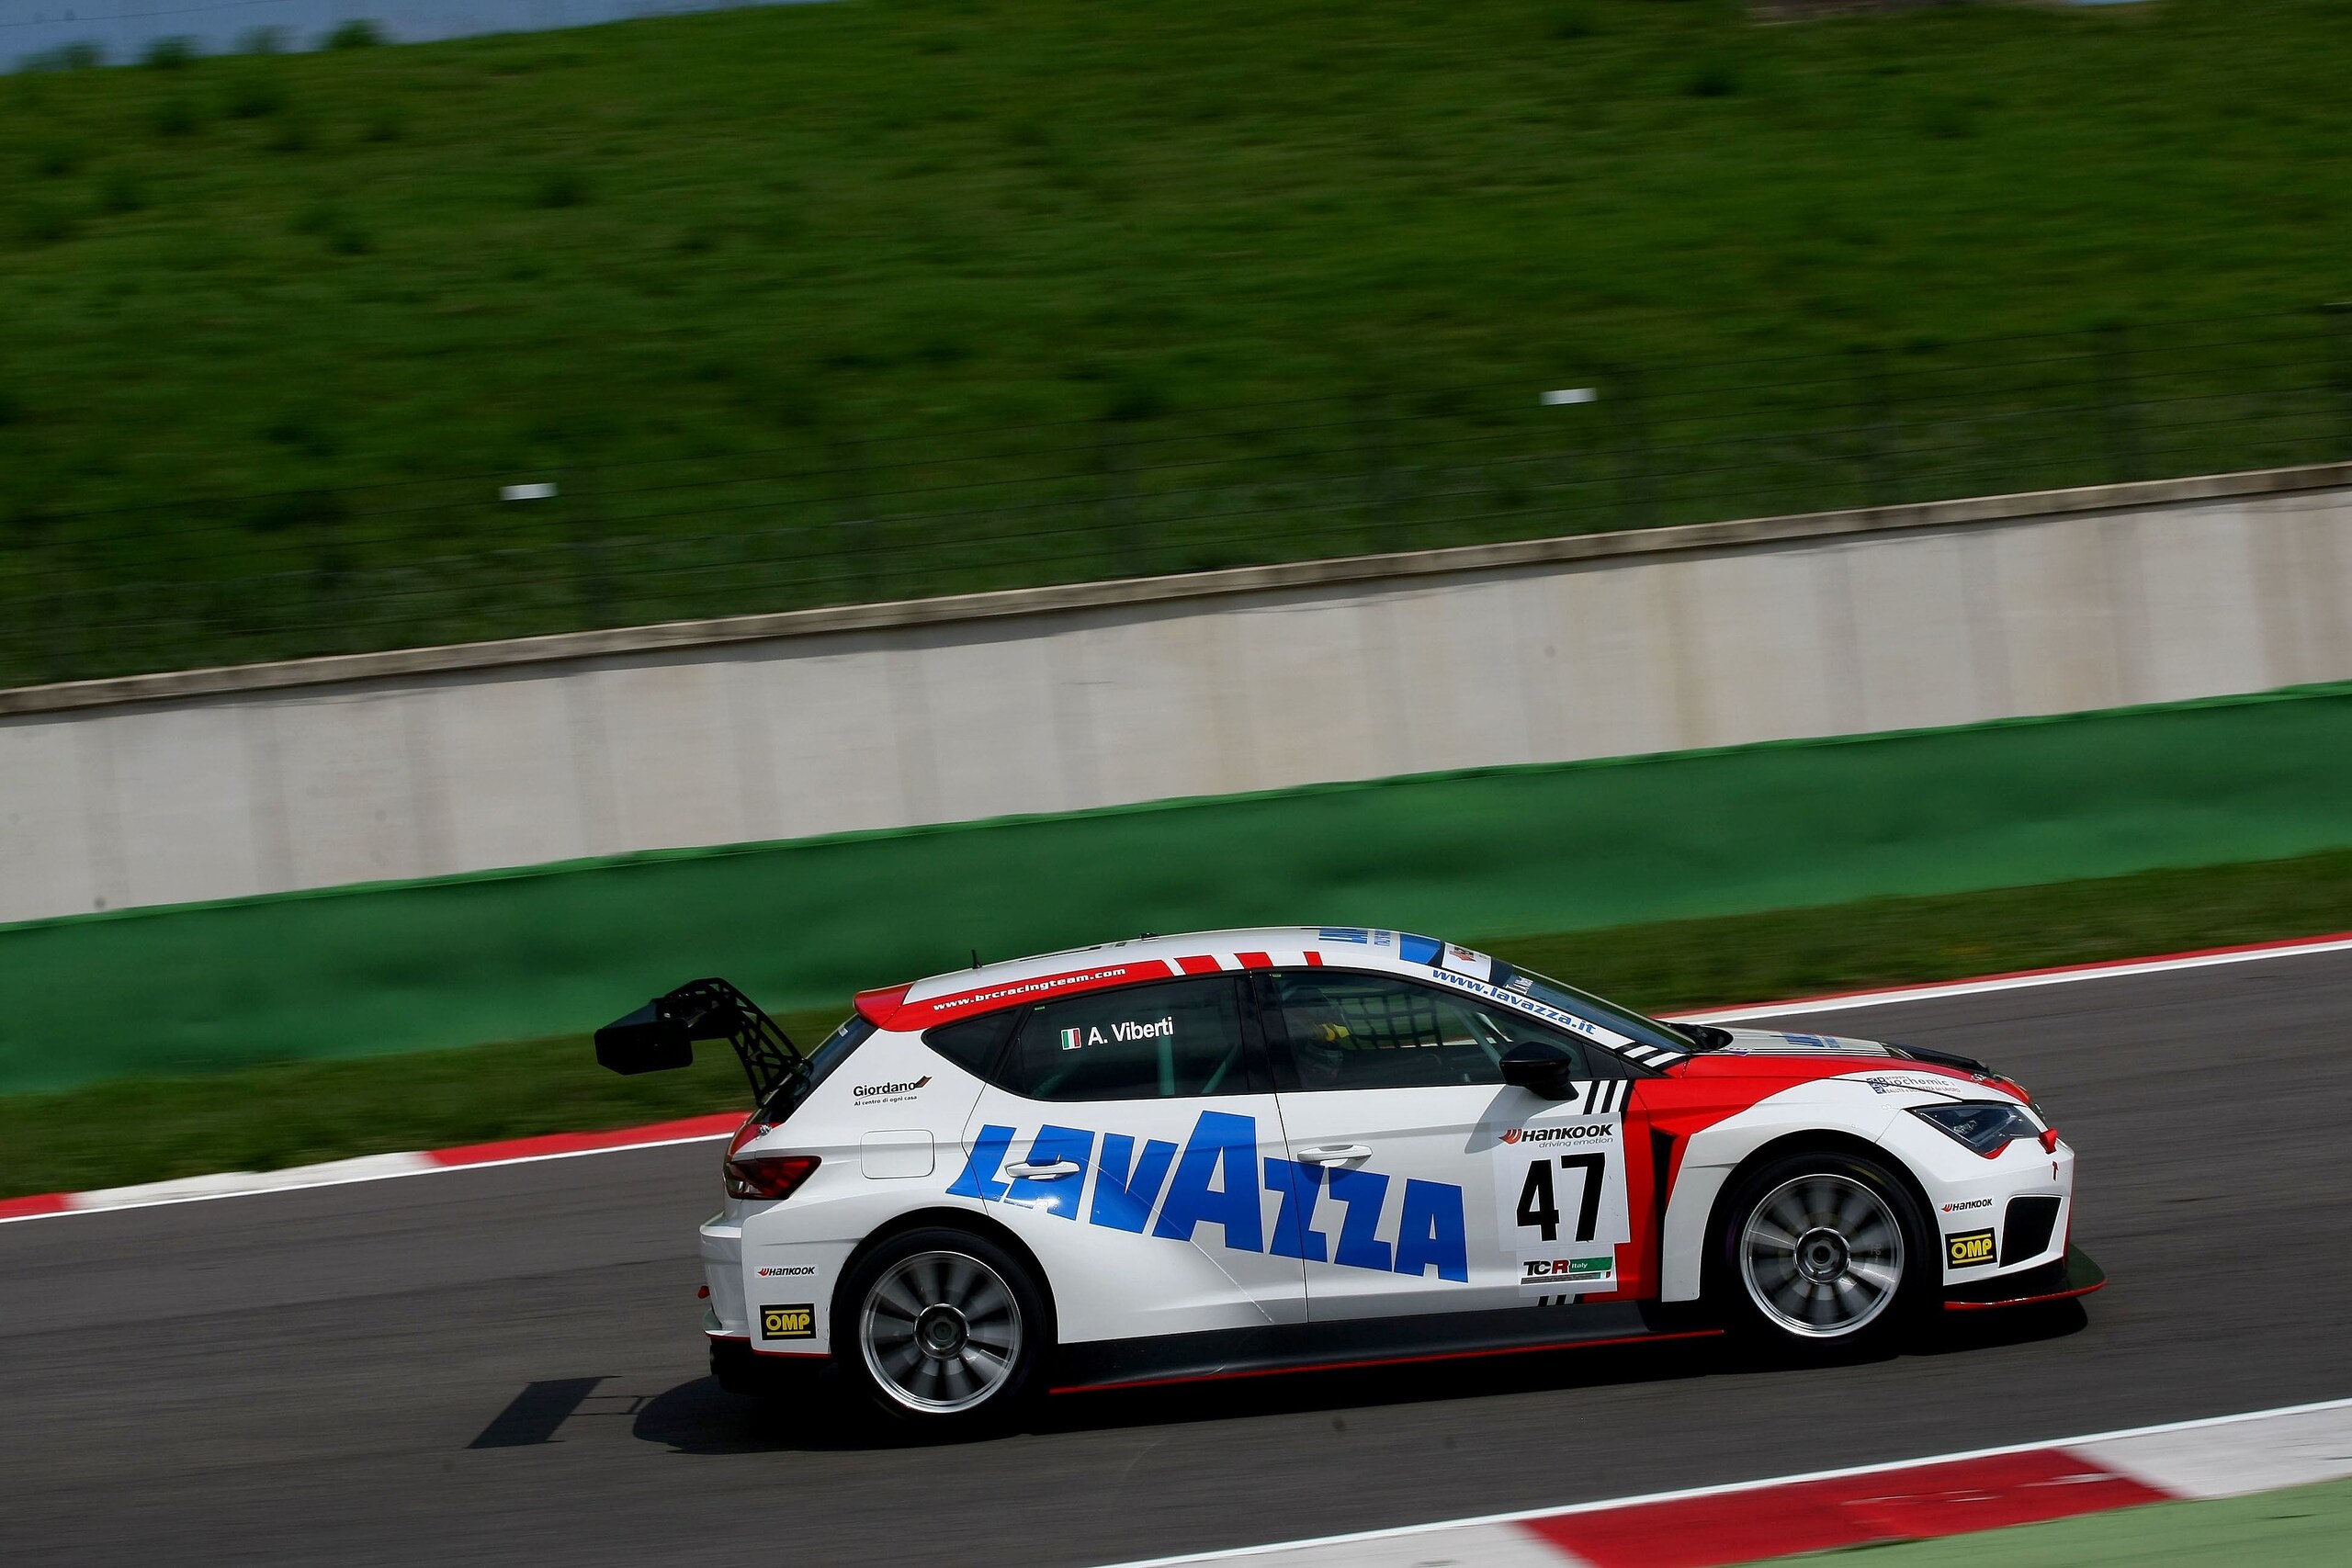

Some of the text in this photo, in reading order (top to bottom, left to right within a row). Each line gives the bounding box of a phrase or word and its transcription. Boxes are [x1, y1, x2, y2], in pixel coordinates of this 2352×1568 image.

[933, 967, 1126, 1011] www.brcracingteam.com
[1432, 968, 1598, 1036] www.lavazza.it
[1088, 1016, 1175, 1046] A. Viberti
[853, 1082, 917, 1097] Giordano
[889, 1096, 903, 1104] ogni
[1539, 1136, 1614, 1149] driving emotion
[945, 1110, 1469, 1283] LAVAZZA
[1516, 1151, 1606, 1243] 47
[1951, 1238, 1992, 1258] OMP
[1522, 1259, 1570, 1276] TCR
[765, 1314, 809, 1331] OMP
